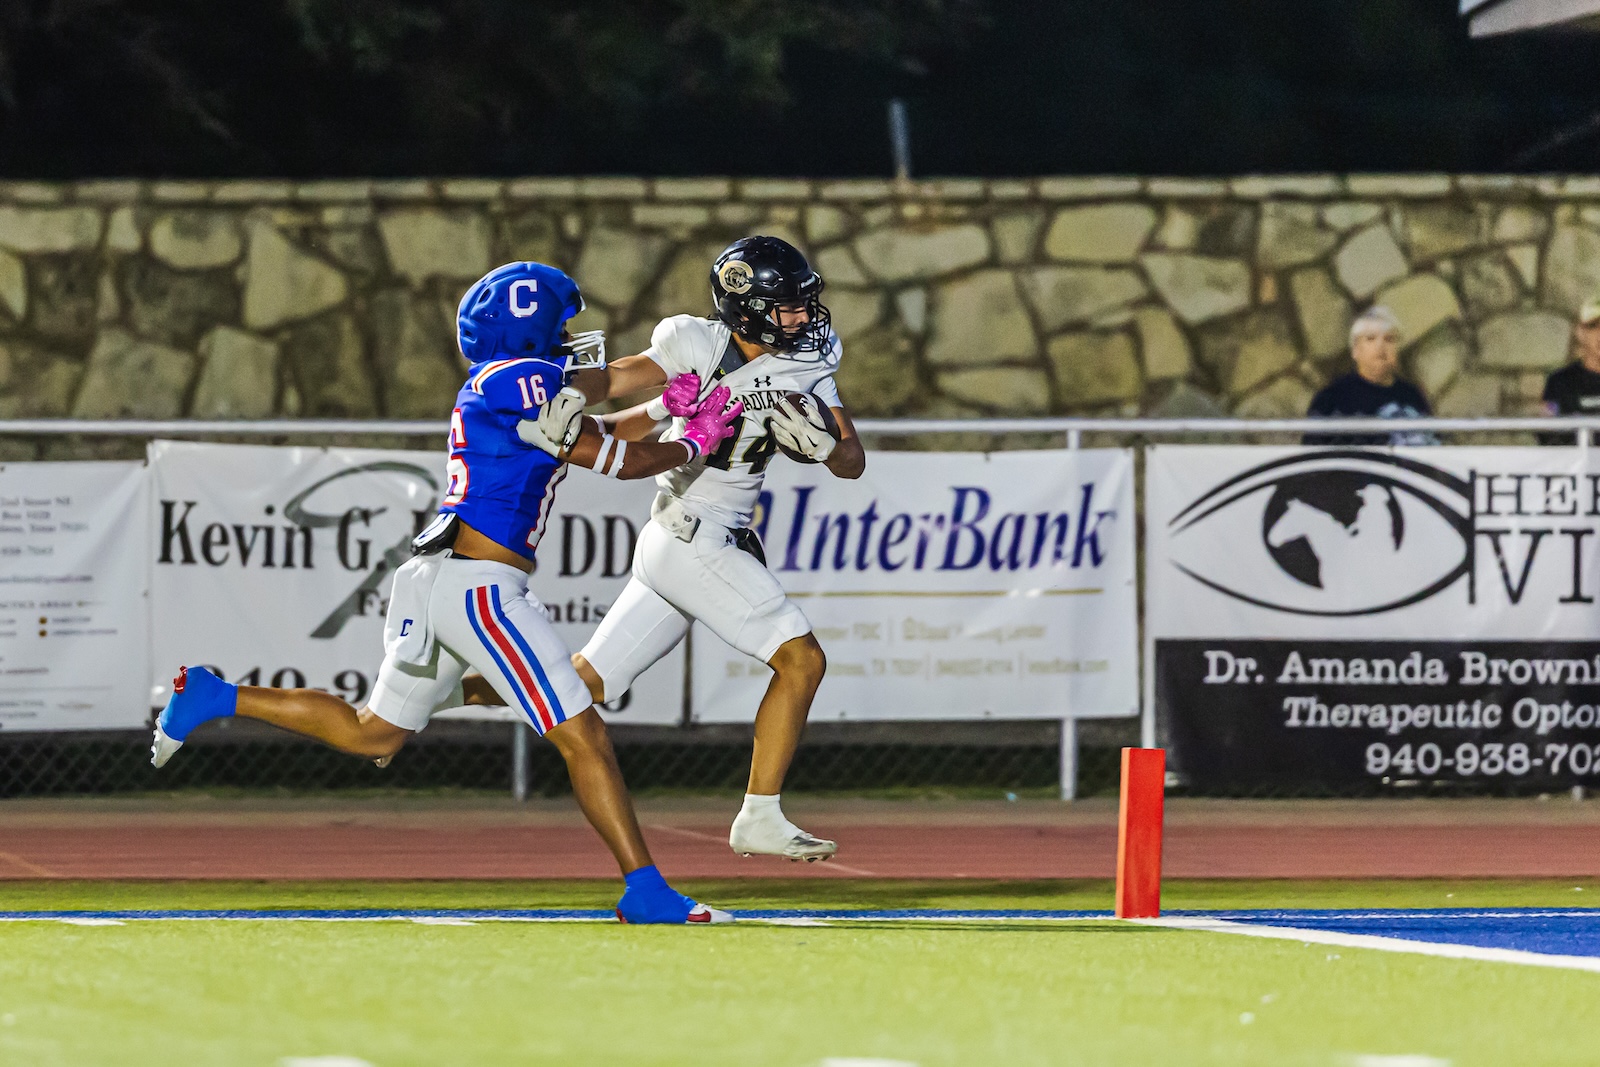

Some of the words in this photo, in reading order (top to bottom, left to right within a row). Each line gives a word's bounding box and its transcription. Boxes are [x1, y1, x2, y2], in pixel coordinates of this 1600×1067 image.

[509, 279, 538, 318] C
[517, 374, 548, 410] 16
[158, 501, 314, 569] Kevin
[338, 507, 385, 571] G.
[776, 483, 1117, 571] InterBank
[400, 619, 413, 636] C
[1203, 651, 1264, 684] Dr.
[1276, 651, 1449, 684] Amanda
[1284, 697, 1502, 734] Therapeutic
